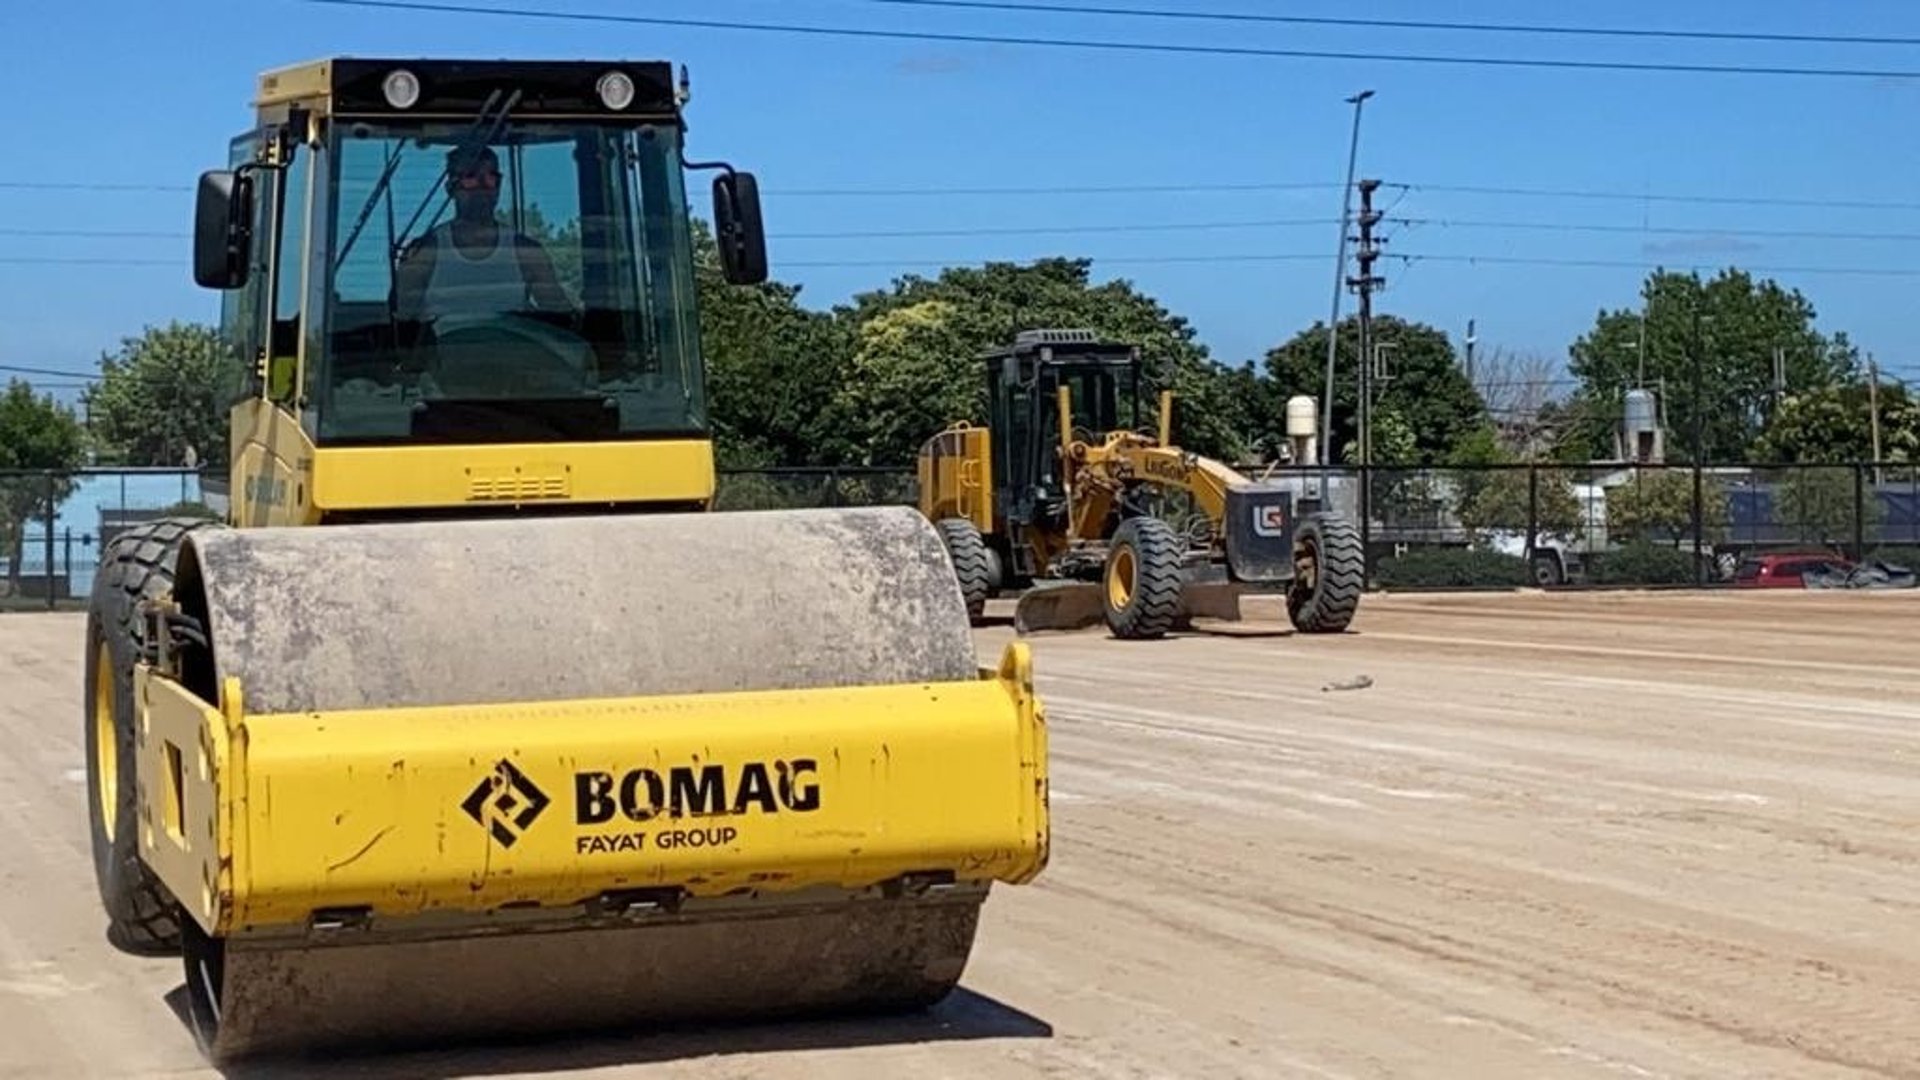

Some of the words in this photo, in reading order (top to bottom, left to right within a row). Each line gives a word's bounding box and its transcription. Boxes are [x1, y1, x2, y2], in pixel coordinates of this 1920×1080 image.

[575, 758, 820, 825] BOMAG
[577, 832, 646, 854] FAYAT
[655, 827, 737, 849] GROUP
